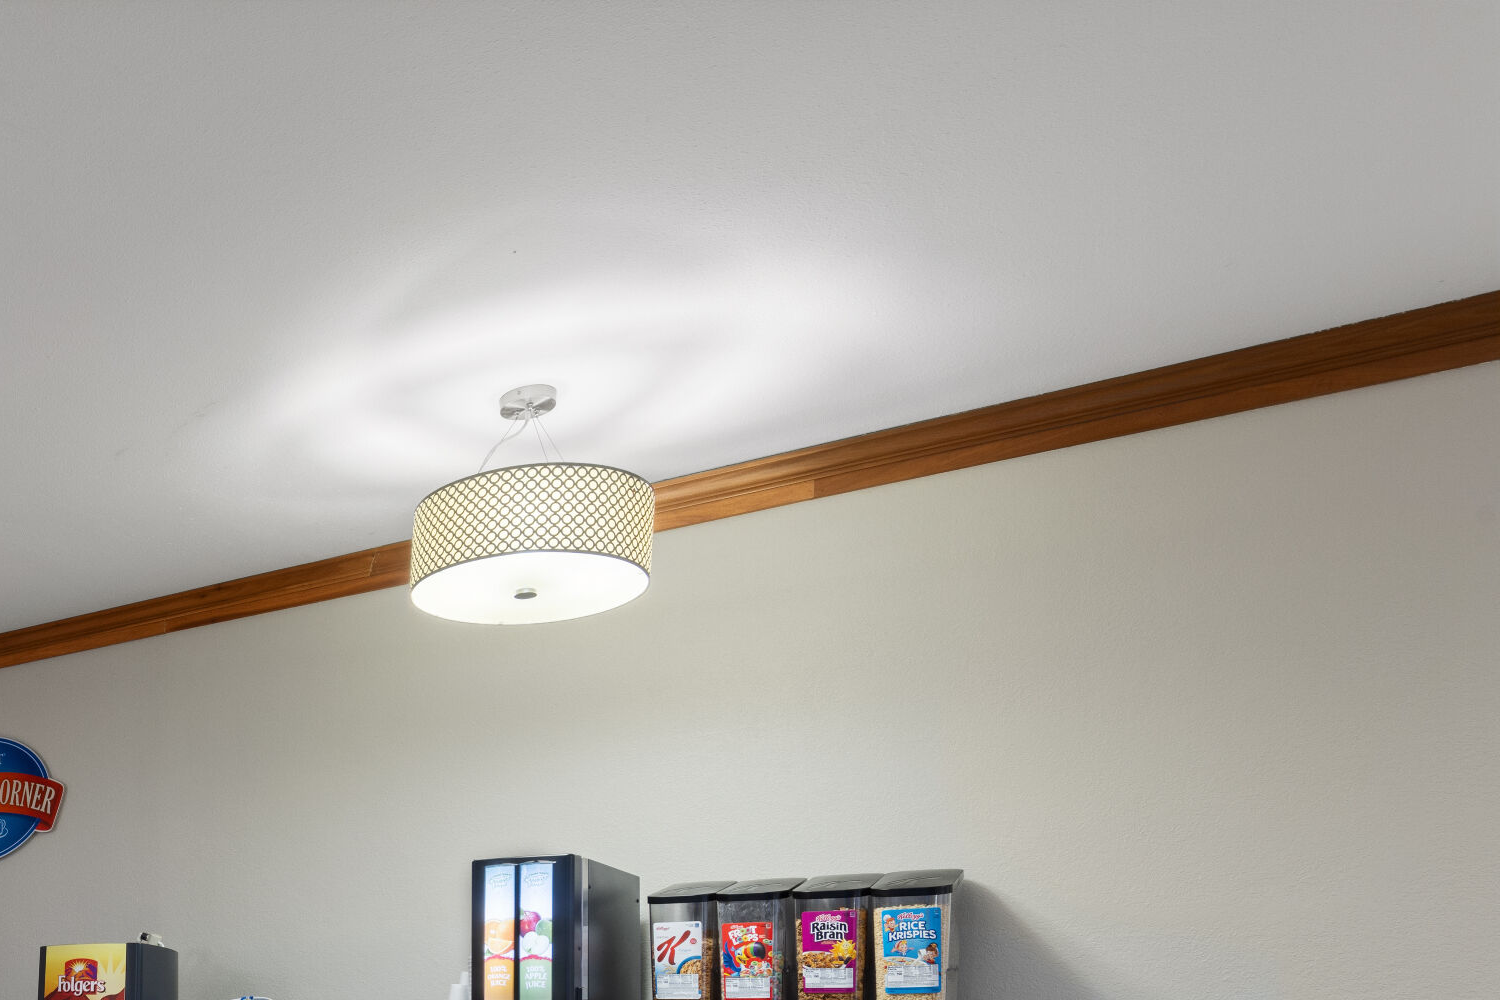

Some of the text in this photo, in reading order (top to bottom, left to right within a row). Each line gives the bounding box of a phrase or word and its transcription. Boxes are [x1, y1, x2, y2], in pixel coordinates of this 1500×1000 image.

[811, 921, 848, 933] Raisin
[899, 921, 926, 931] RICE
[815, 931, 844, 941] Bran
[888, 929, 937, 942] KRISPIES
[57, 975, 106, 996] Folgers
